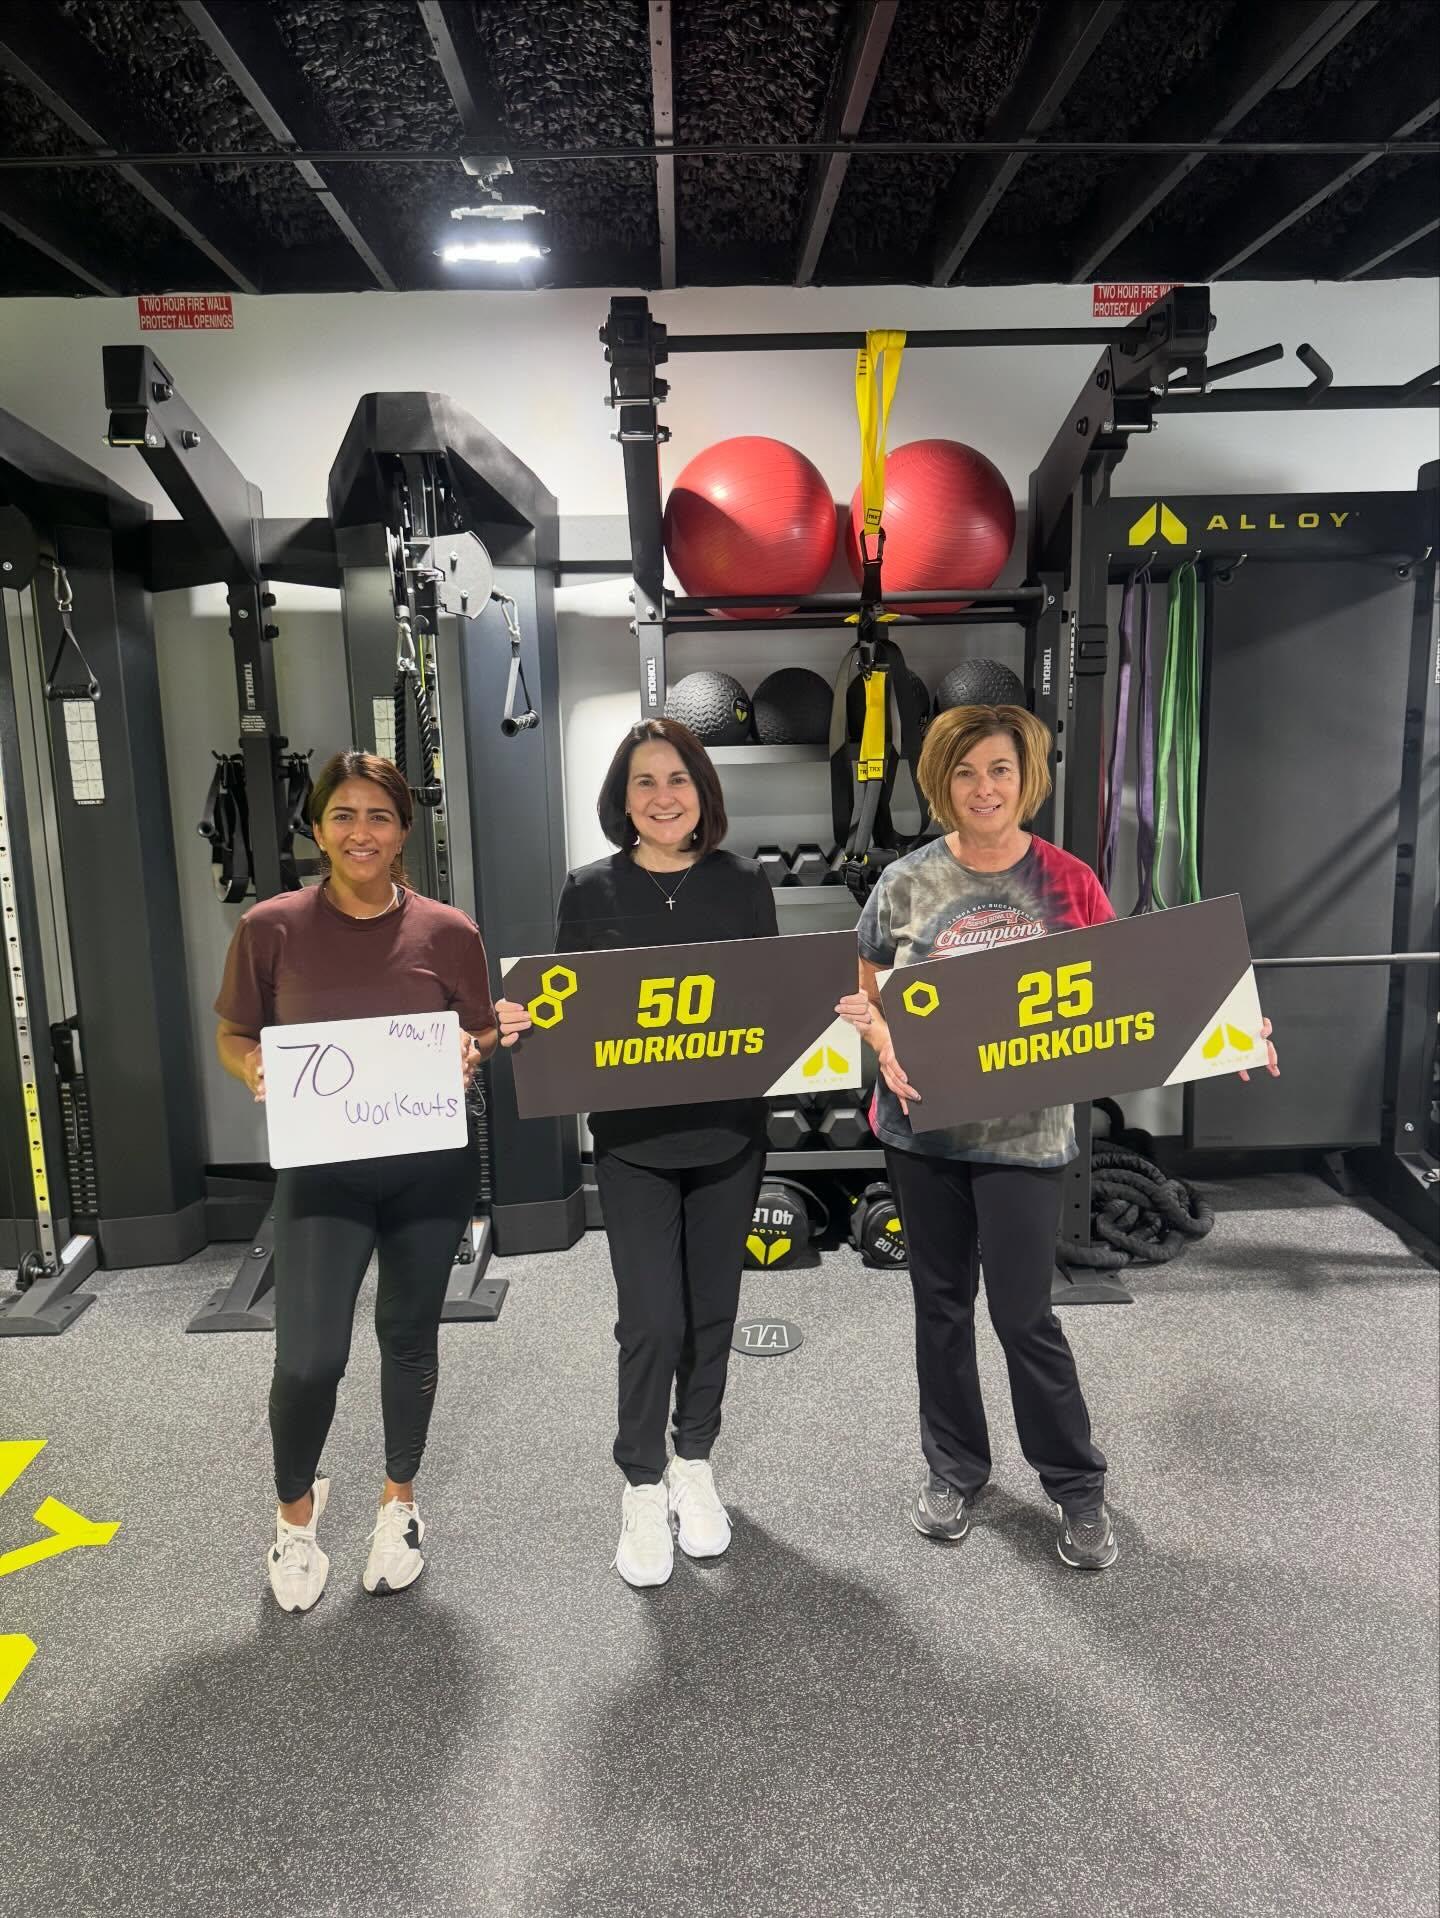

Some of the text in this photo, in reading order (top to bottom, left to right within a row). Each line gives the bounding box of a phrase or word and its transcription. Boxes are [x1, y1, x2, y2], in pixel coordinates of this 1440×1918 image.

[1098, 285, 1116, 299] TWO
[1117, 285, 1139, 299] HOUR
[1141, 285, 1158, 299] FIRE
[142, 297, 229, 312] TWO HOUR FIRE WALL
[1094, 302, 1128, 316] PROTECT
[1129, 302, 1142, 315] ALL
[141, 314, 233, 329] PROTECT ALL OPENINGS
[1206, 512, 1350, 530] ALLOY
[947, 909, 971, 925] TAMPA
[972, 904, 986, 912] BAY
[936, 920, 1046, 949] Champions
[637, 974, 716, 1028] 50
[1017, 960, 1094, 1028] 25
[594, 1027, 765, 1068] WORKOUTS
[978, 1011, 1156, 1073] WORKOUTS
[276, 1043, 355, 1098] 70
[772, 1209, 794, 1226] 40
[874, 1237, 906, 1260] 20 LB
[741, 1324, 789, 1348] 1A
